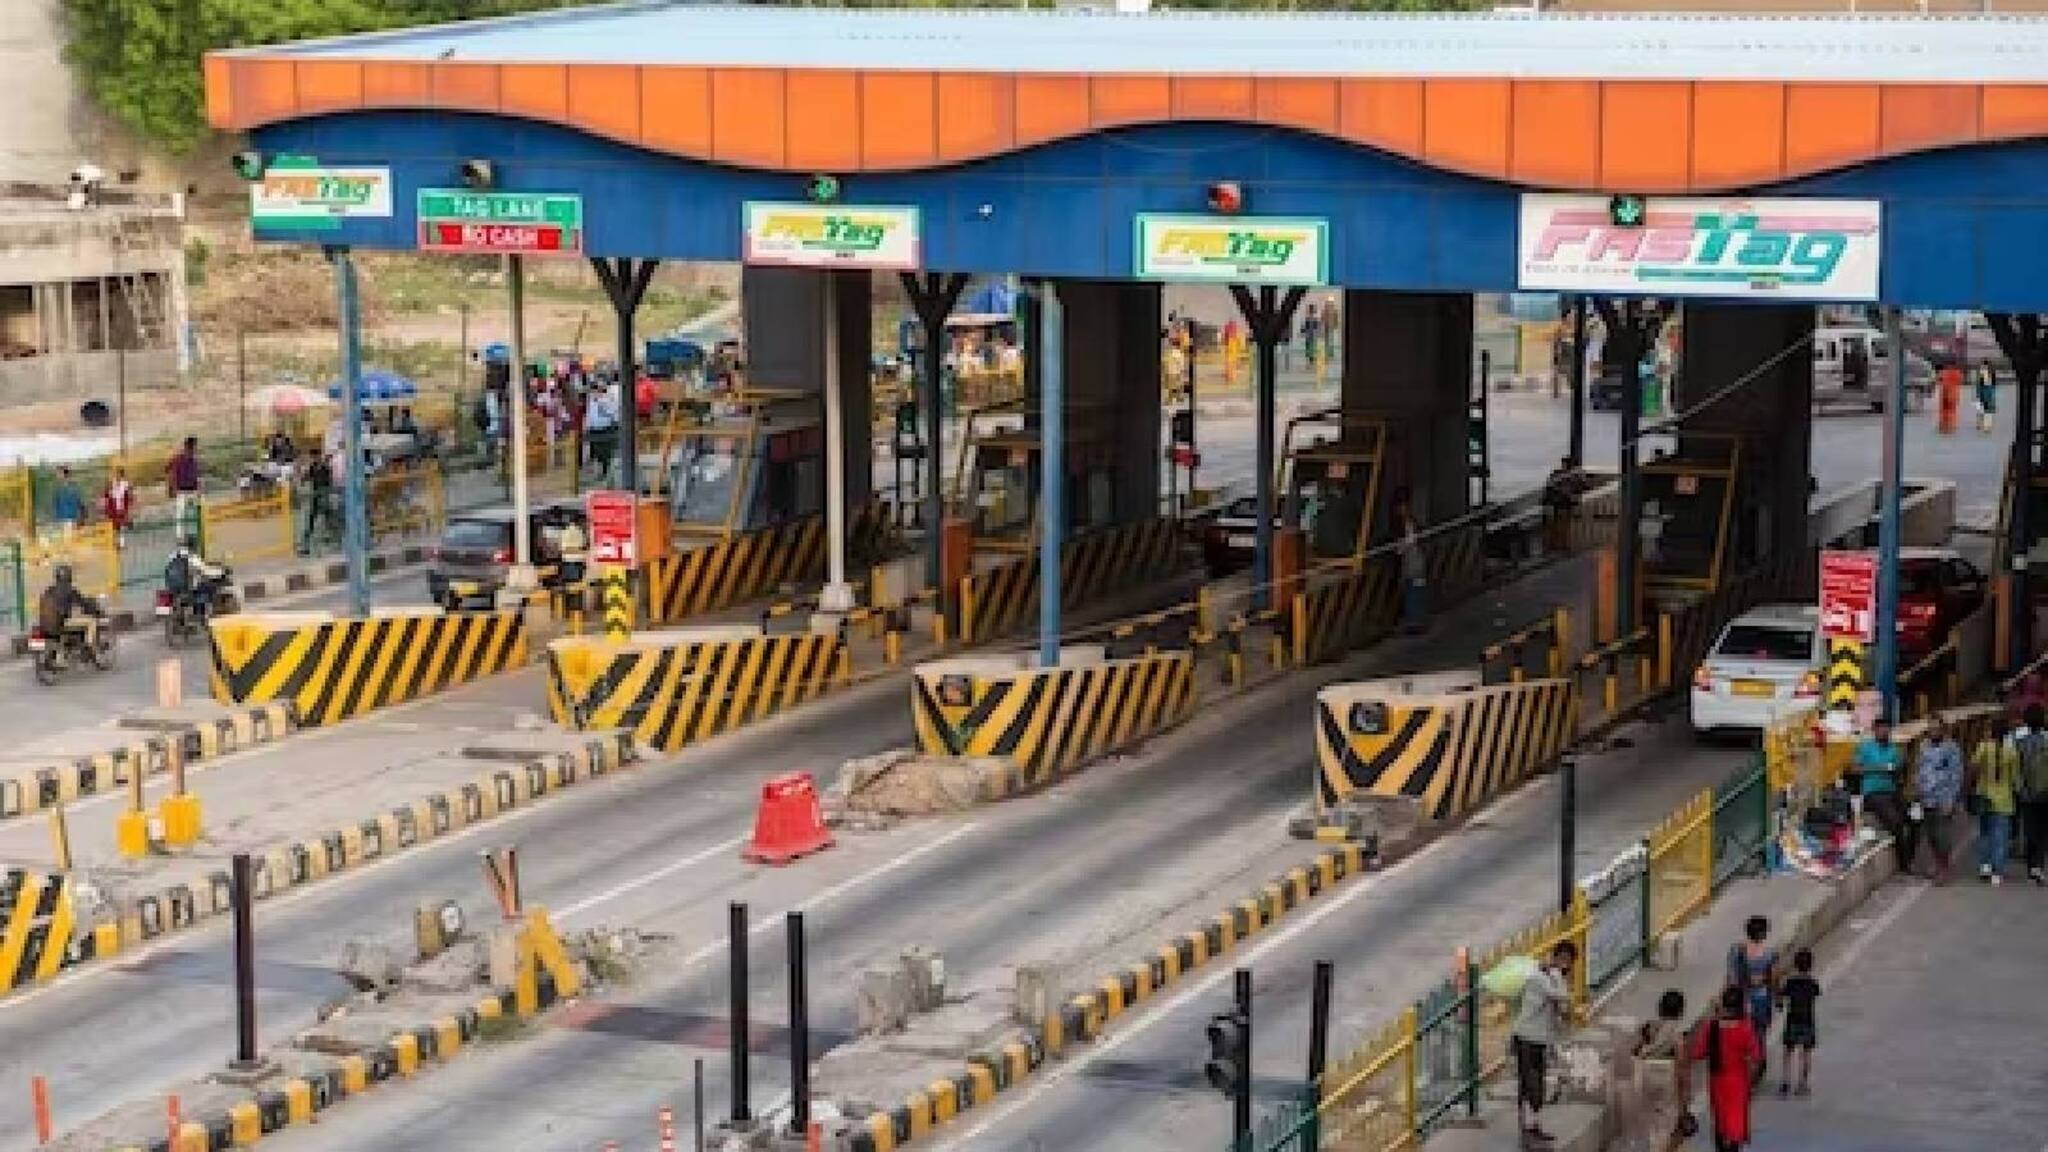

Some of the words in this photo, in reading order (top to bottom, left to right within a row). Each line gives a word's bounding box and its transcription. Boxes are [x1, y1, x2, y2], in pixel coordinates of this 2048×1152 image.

[453, 199, 489, 217] TAG
[491, 225, 537, 246] CASH
[1532, 211, 1850, 282] FASTag
